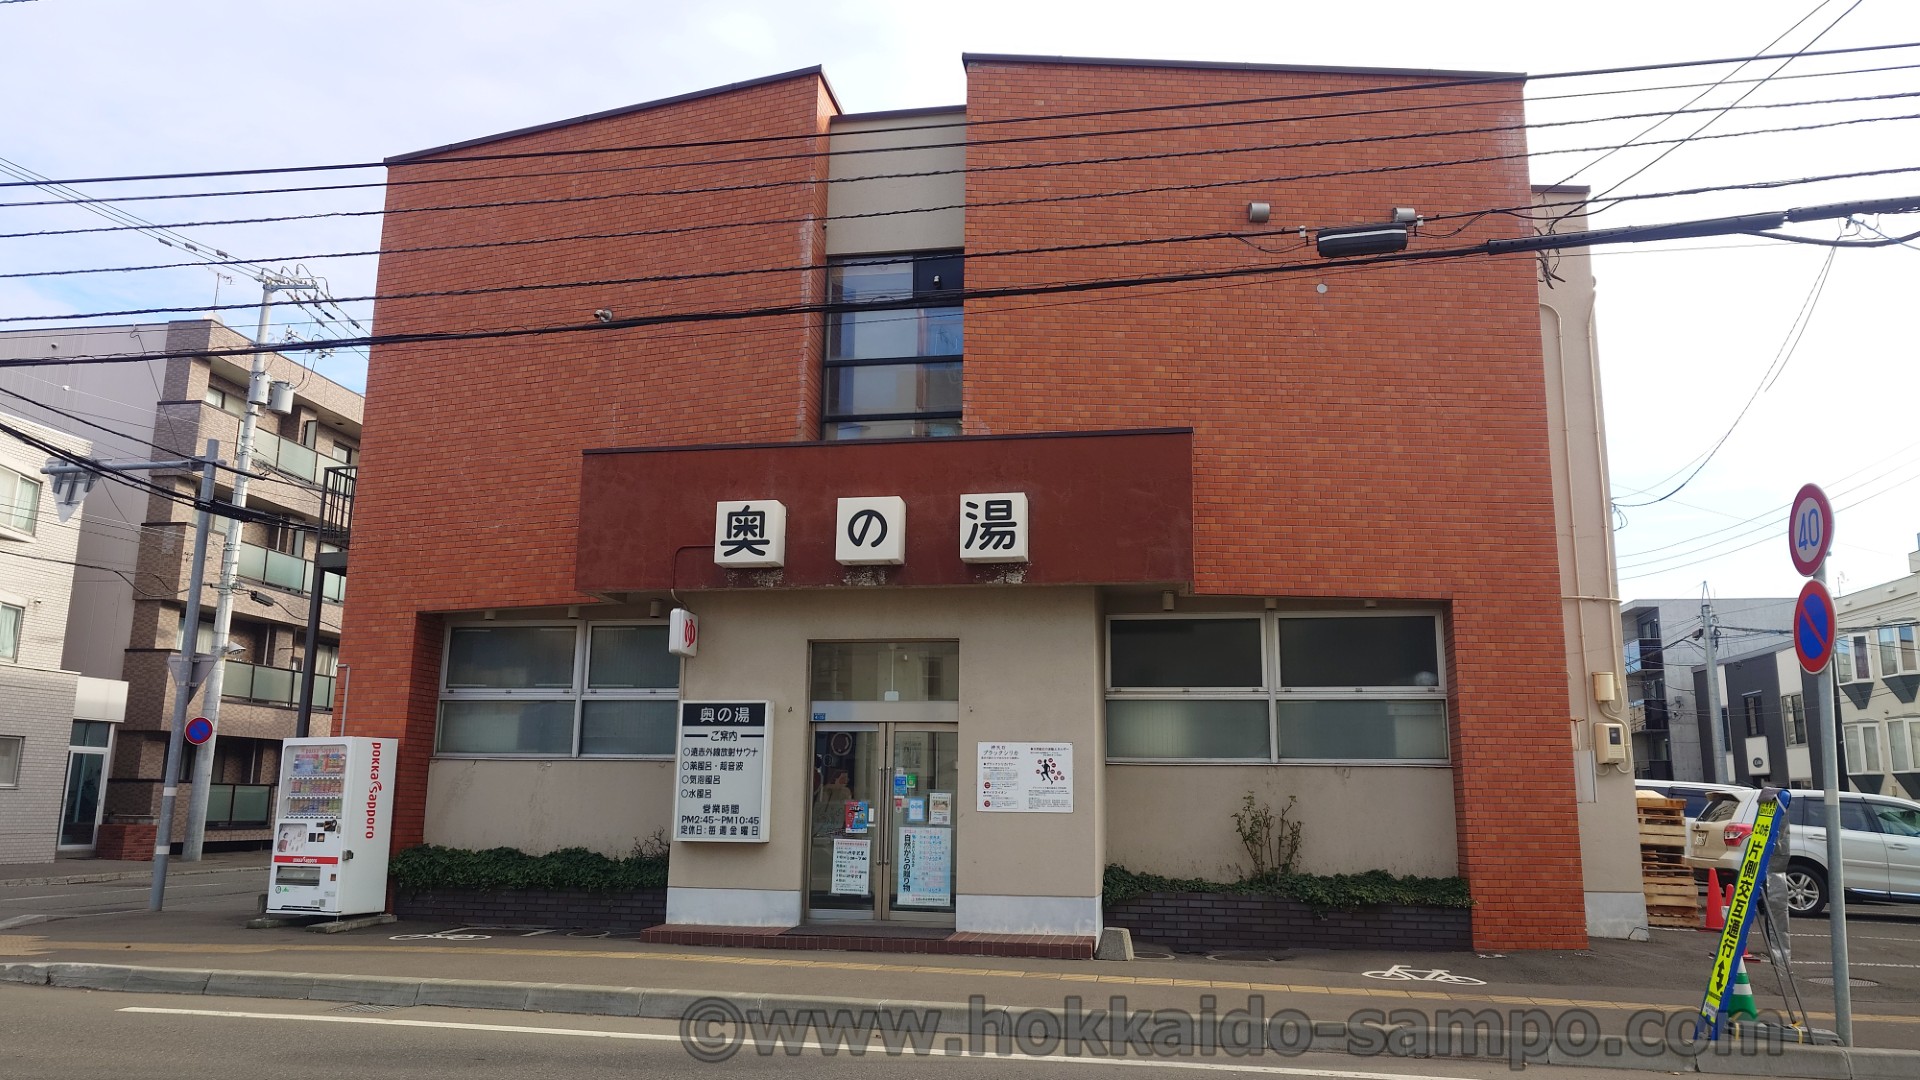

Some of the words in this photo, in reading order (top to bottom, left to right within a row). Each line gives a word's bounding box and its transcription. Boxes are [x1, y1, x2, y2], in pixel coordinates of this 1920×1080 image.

[720, 500, 1017, 557] 奥の湯
[1798, 508, 1820, 550] 40
[685, 619, 696, 648] ゆ
[700, 707, 750, 723] 奥の湯
[710, 730, 738, 742] ご案内
[370, 742, 382, 780] pokka
[702, 804, 740, 815] 営業時間
[1721, 840, 1763, 959] 片側交互通行
